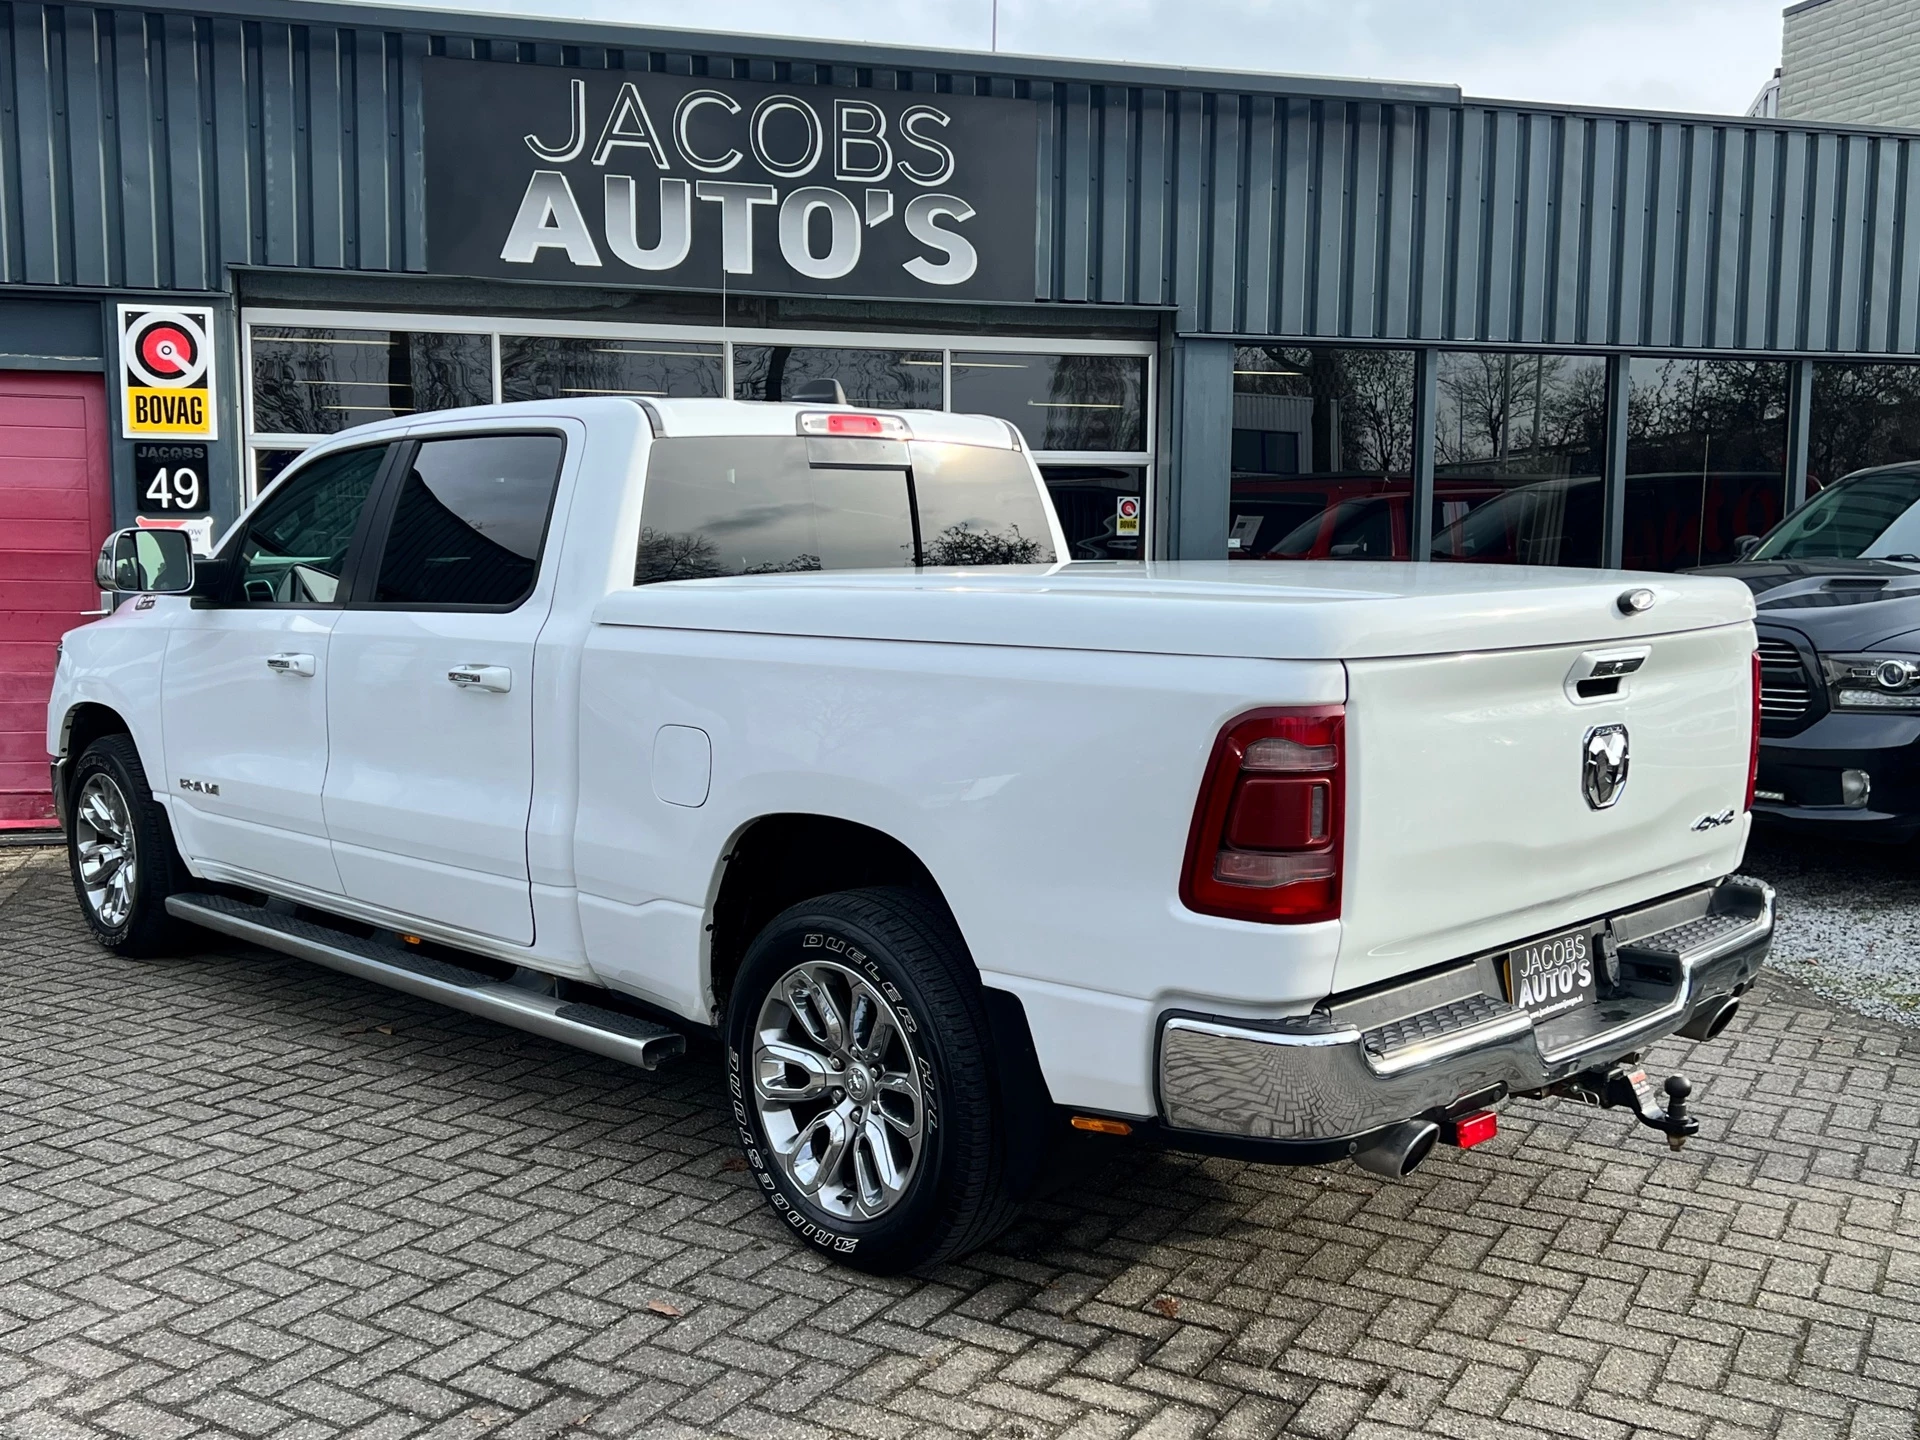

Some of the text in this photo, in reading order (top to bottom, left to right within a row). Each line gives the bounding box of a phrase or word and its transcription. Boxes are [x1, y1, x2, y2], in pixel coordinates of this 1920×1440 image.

[524, 79, 955, 187] JACOBS
[500, 170, 978, 286] AUTO'S
[135, 395, 203, 426] BOVAG
[137, 446, 205, 460] JACOBS
[146, 467, 200, 510] 49
[1119, 520, 1137, 529] BOVAG
[180, 778, 220, 797] RAM
[1520, 934, 1586, 977] JACOBS
[803, 933, 917, 1033] DUELER
[1518, 959, 1592, 1009] AUTO'S
[729, 1046, 859, 1253] BRIDGESTONE
